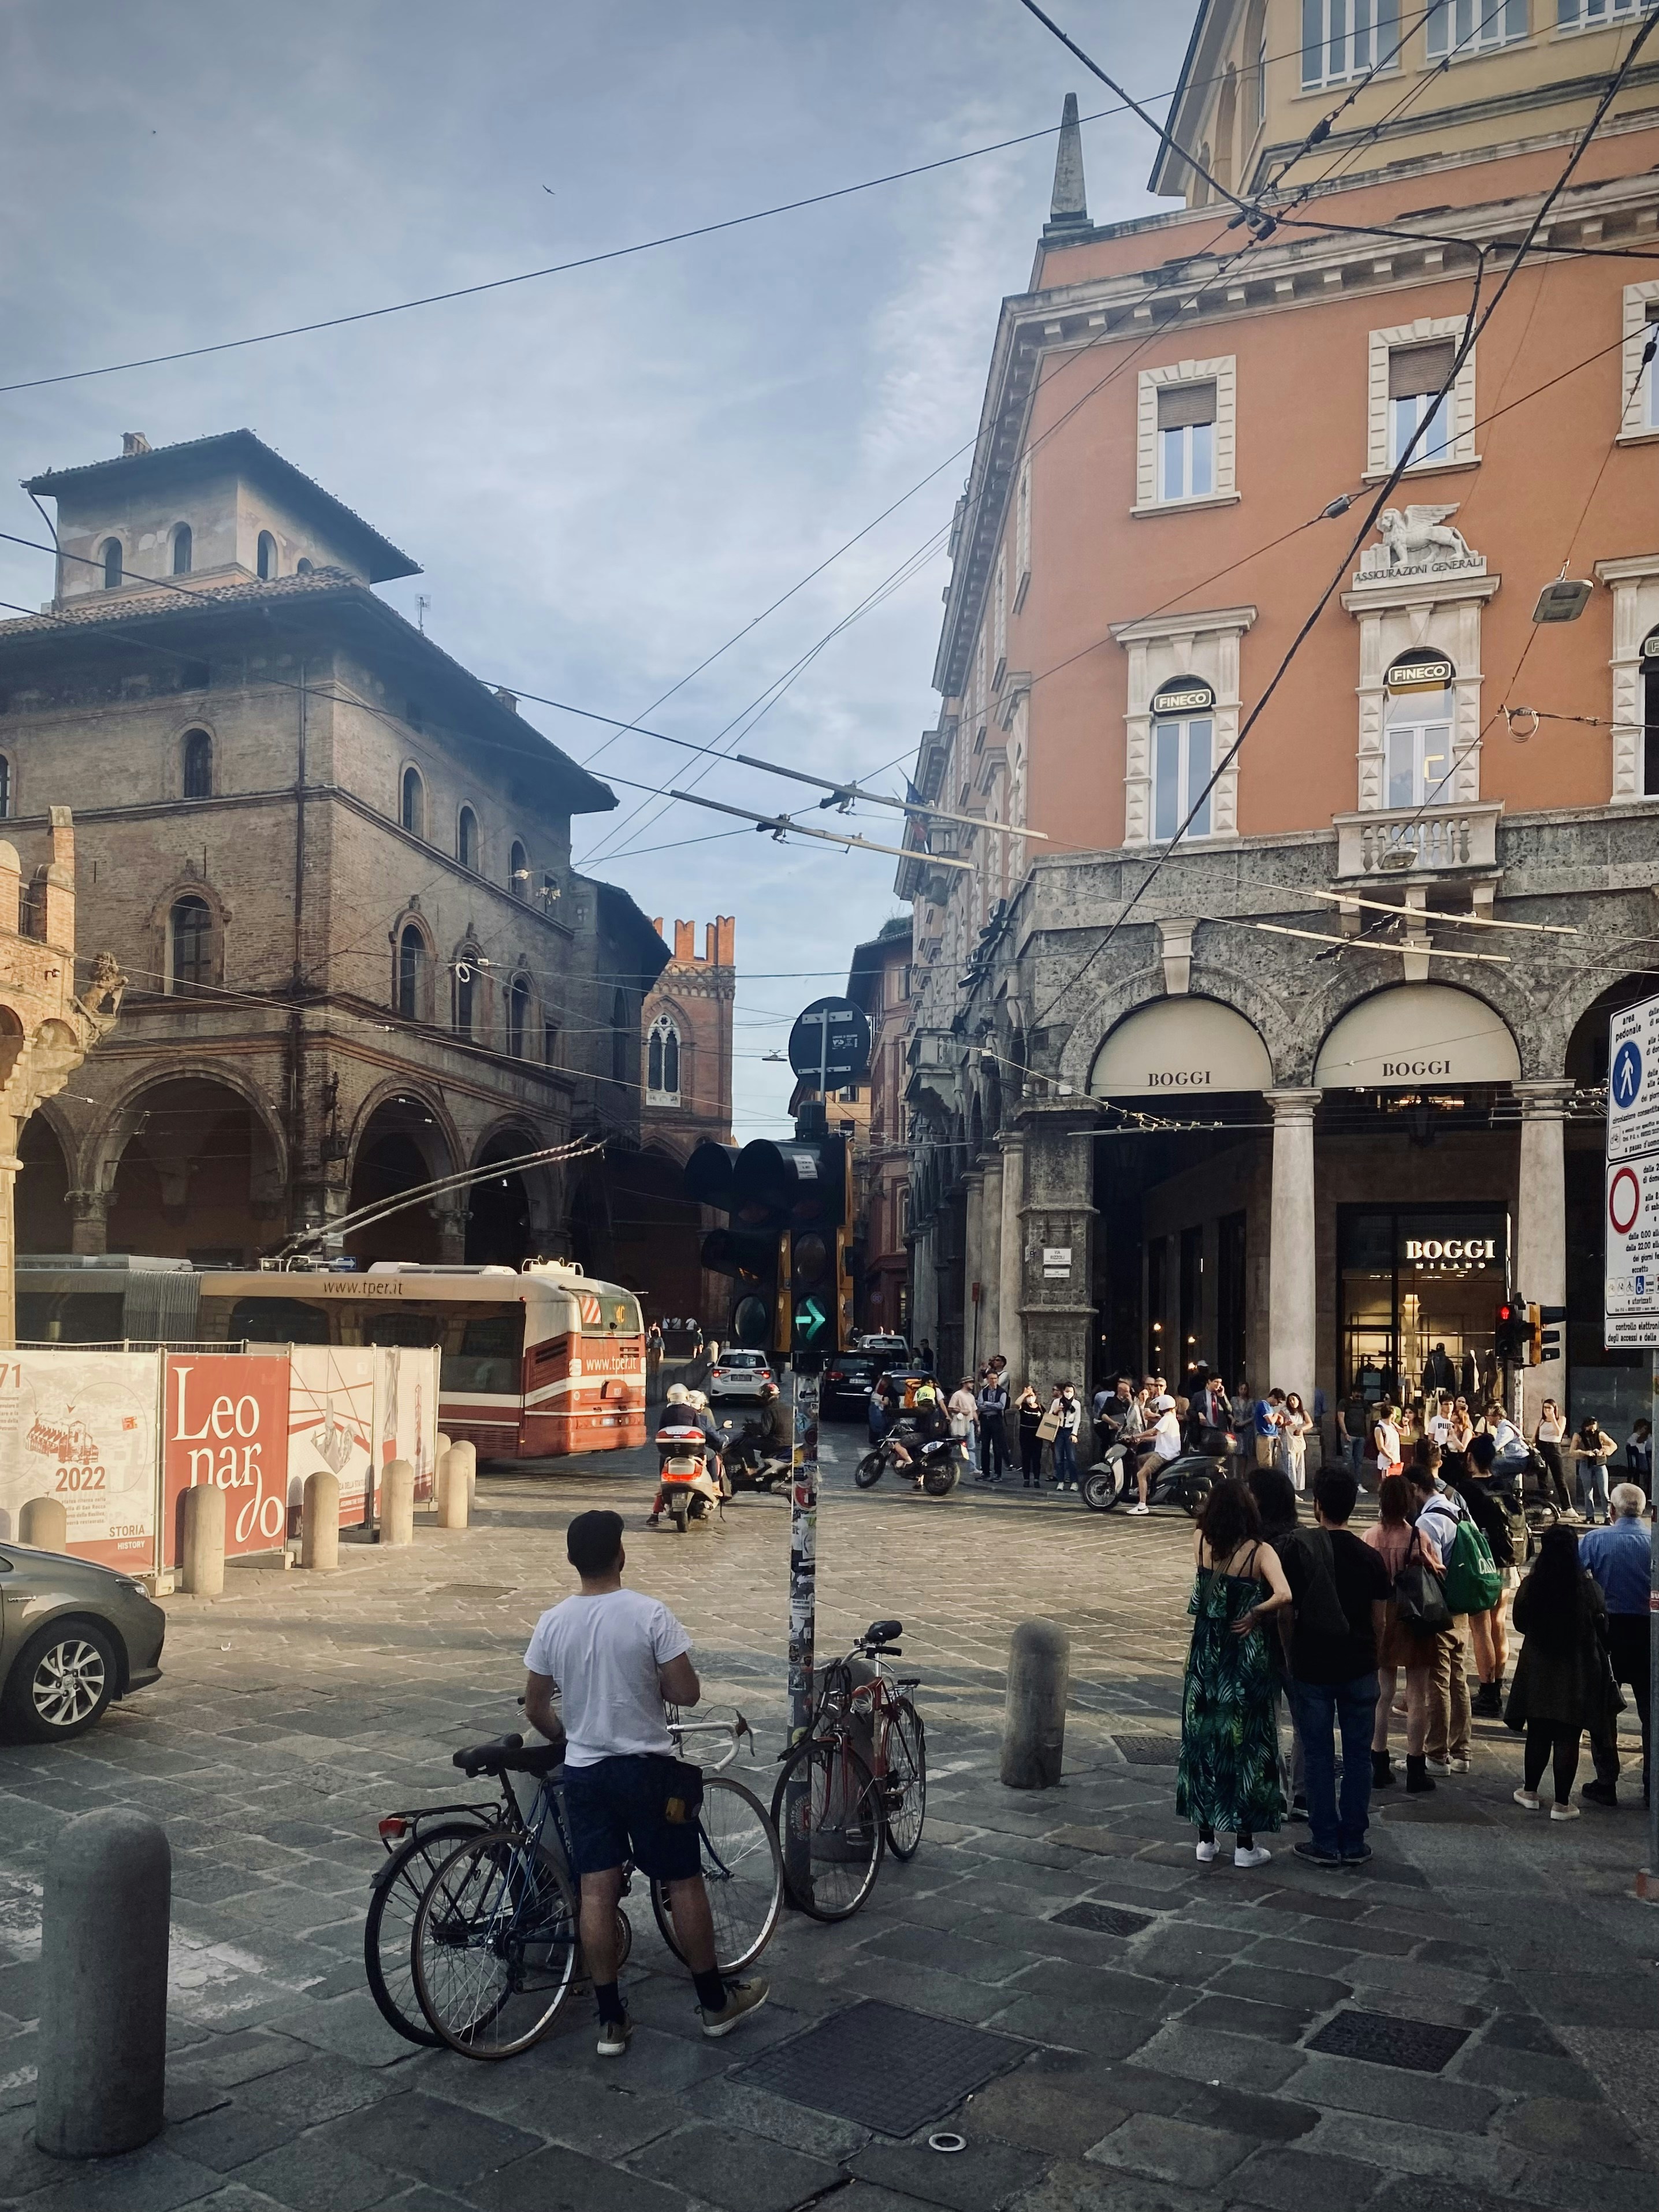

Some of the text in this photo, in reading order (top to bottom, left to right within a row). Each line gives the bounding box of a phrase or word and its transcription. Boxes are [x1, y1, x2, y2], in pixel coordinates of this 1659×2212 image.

[1354, 557, 1483, 583] ASSICURAZIONI GENERALI
[1394, 665, 1446, 682] FINECO
[1159, 693, 1207, 708] FINECO
[1623, 1014, 1634, 1025] area
[1616, 1023, 1641, 1044] pedonale
[1382, 1060, 1450, 1077] BOGGI
[1147, 1071, 1211, 1086] BOGGI
[1406, 1240, 1496, 1259] BOGGI
[1638, 1242, 1650, 1250] 22.00
[1632, 1265, 1649, 1273] eccetto
[323, 1279, 404, 1297] www.tper.it
[1615, 1322, 1636, 1331] controllo
[1608, 1334, 1619, 1343] degli
[1621, 1333, 1638, 1341] accessi
[1645, 1332, 1657, 1341] delle
[586, 1356, 637, 1375] www.tper.it
[171, 1366, 260, 1441] Leo
[55, 1466, 106, 1492] 2022
[109, 1524, 145, 1537] STORIA
[117, 1540, 145, 1550] HISTORY
